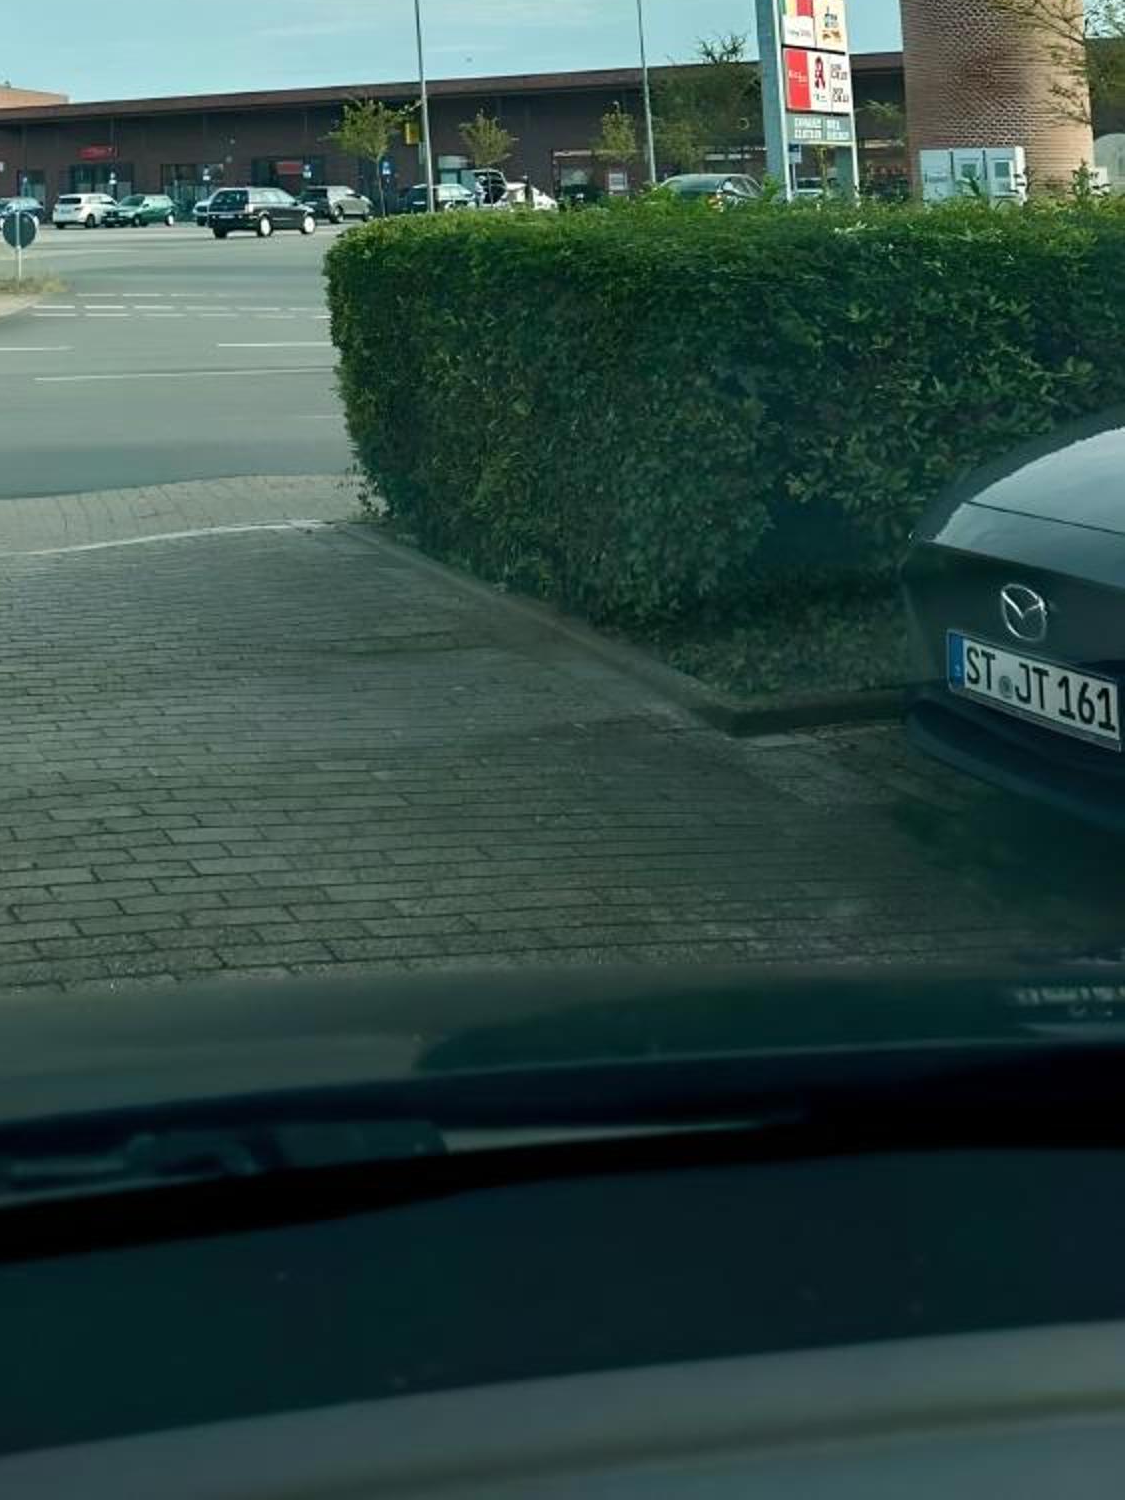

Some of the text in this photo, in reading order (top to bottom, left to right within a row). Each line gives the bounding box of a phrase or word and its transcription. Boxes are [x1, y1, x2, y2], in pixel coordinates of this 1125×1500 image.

[966, 646, 1116, 733] ST JT 161
